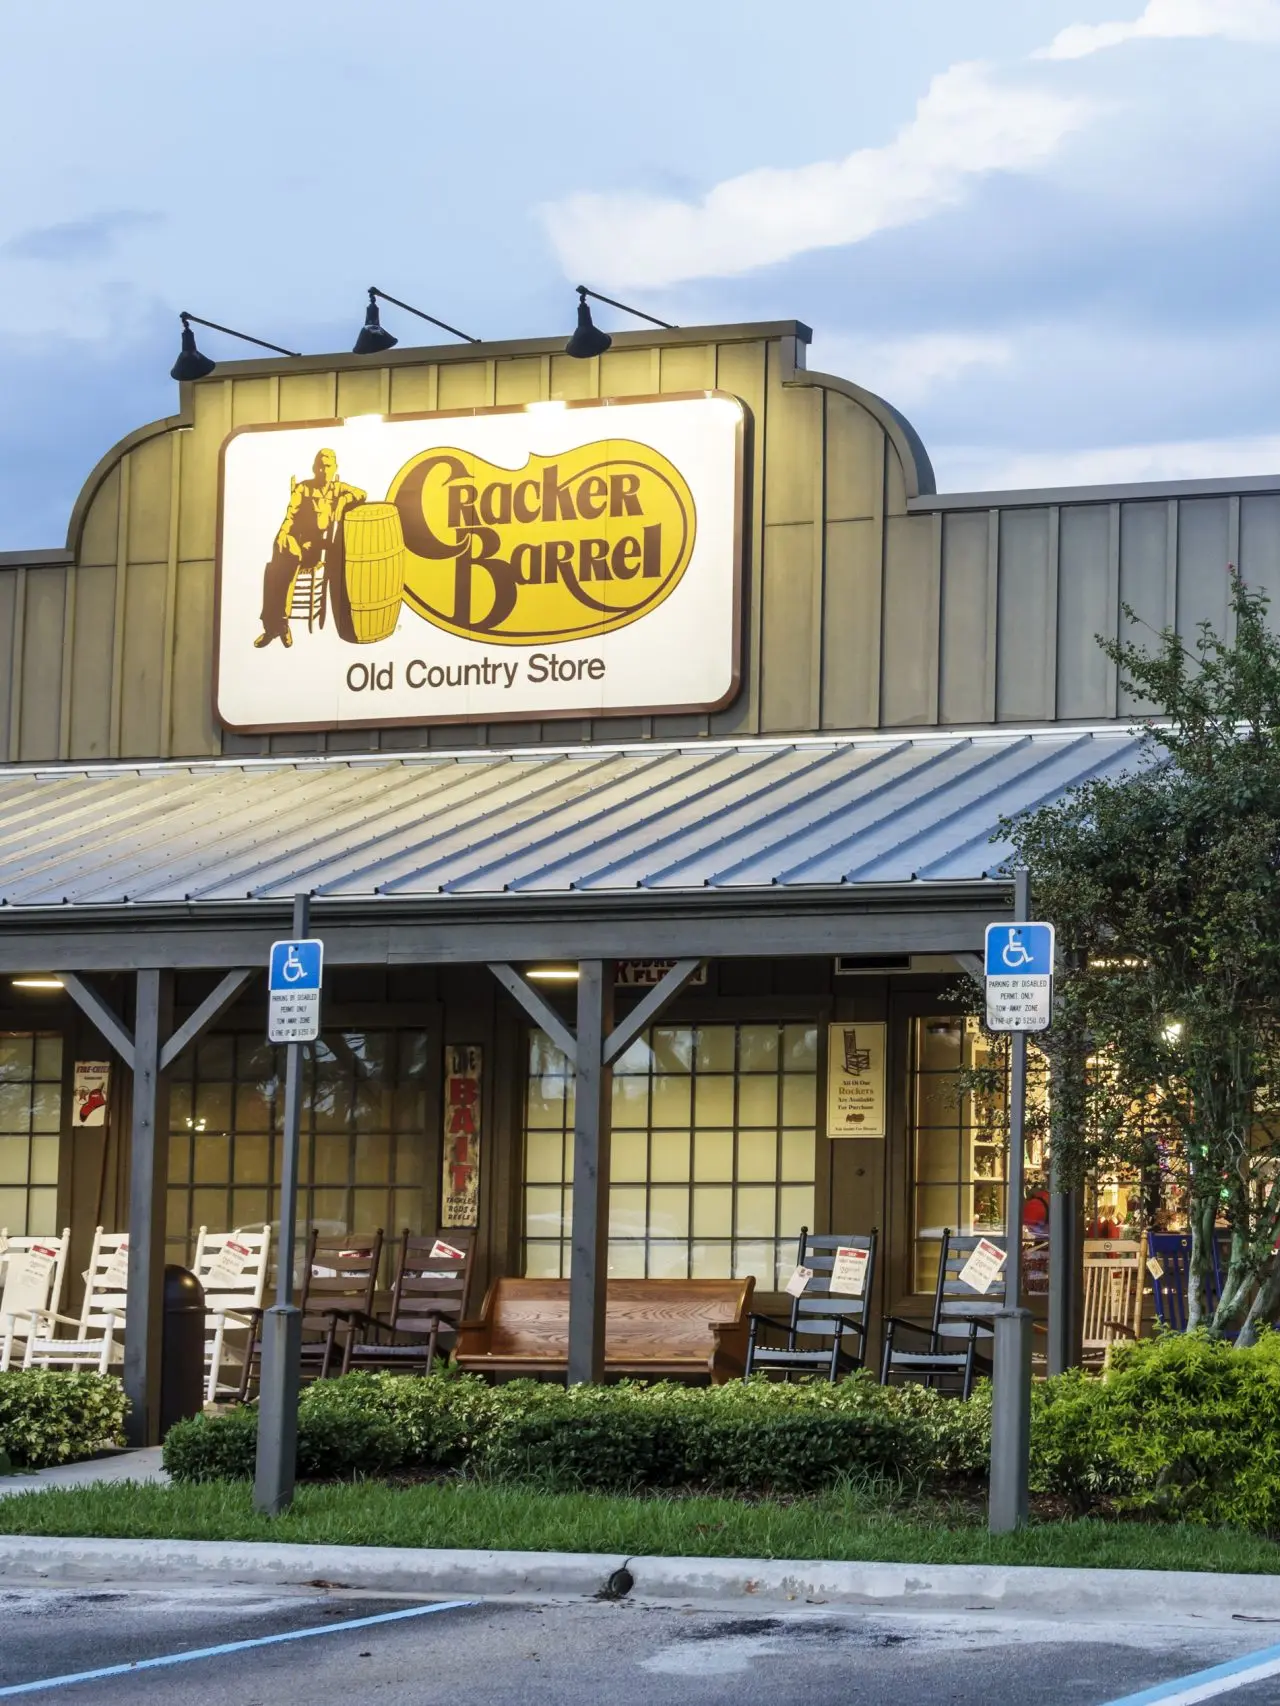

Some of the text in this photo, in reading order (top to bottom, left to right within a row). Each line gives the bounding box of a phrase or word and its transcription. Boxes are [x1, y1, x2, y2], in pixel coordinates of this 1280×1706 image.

[346, 653, 606, 692] Old Country Store
[989, 980, 1009, 988] PARKING
[838, 1087, 874, 1095] Rockers
[449, 1078, 477, 1192] BAIT
